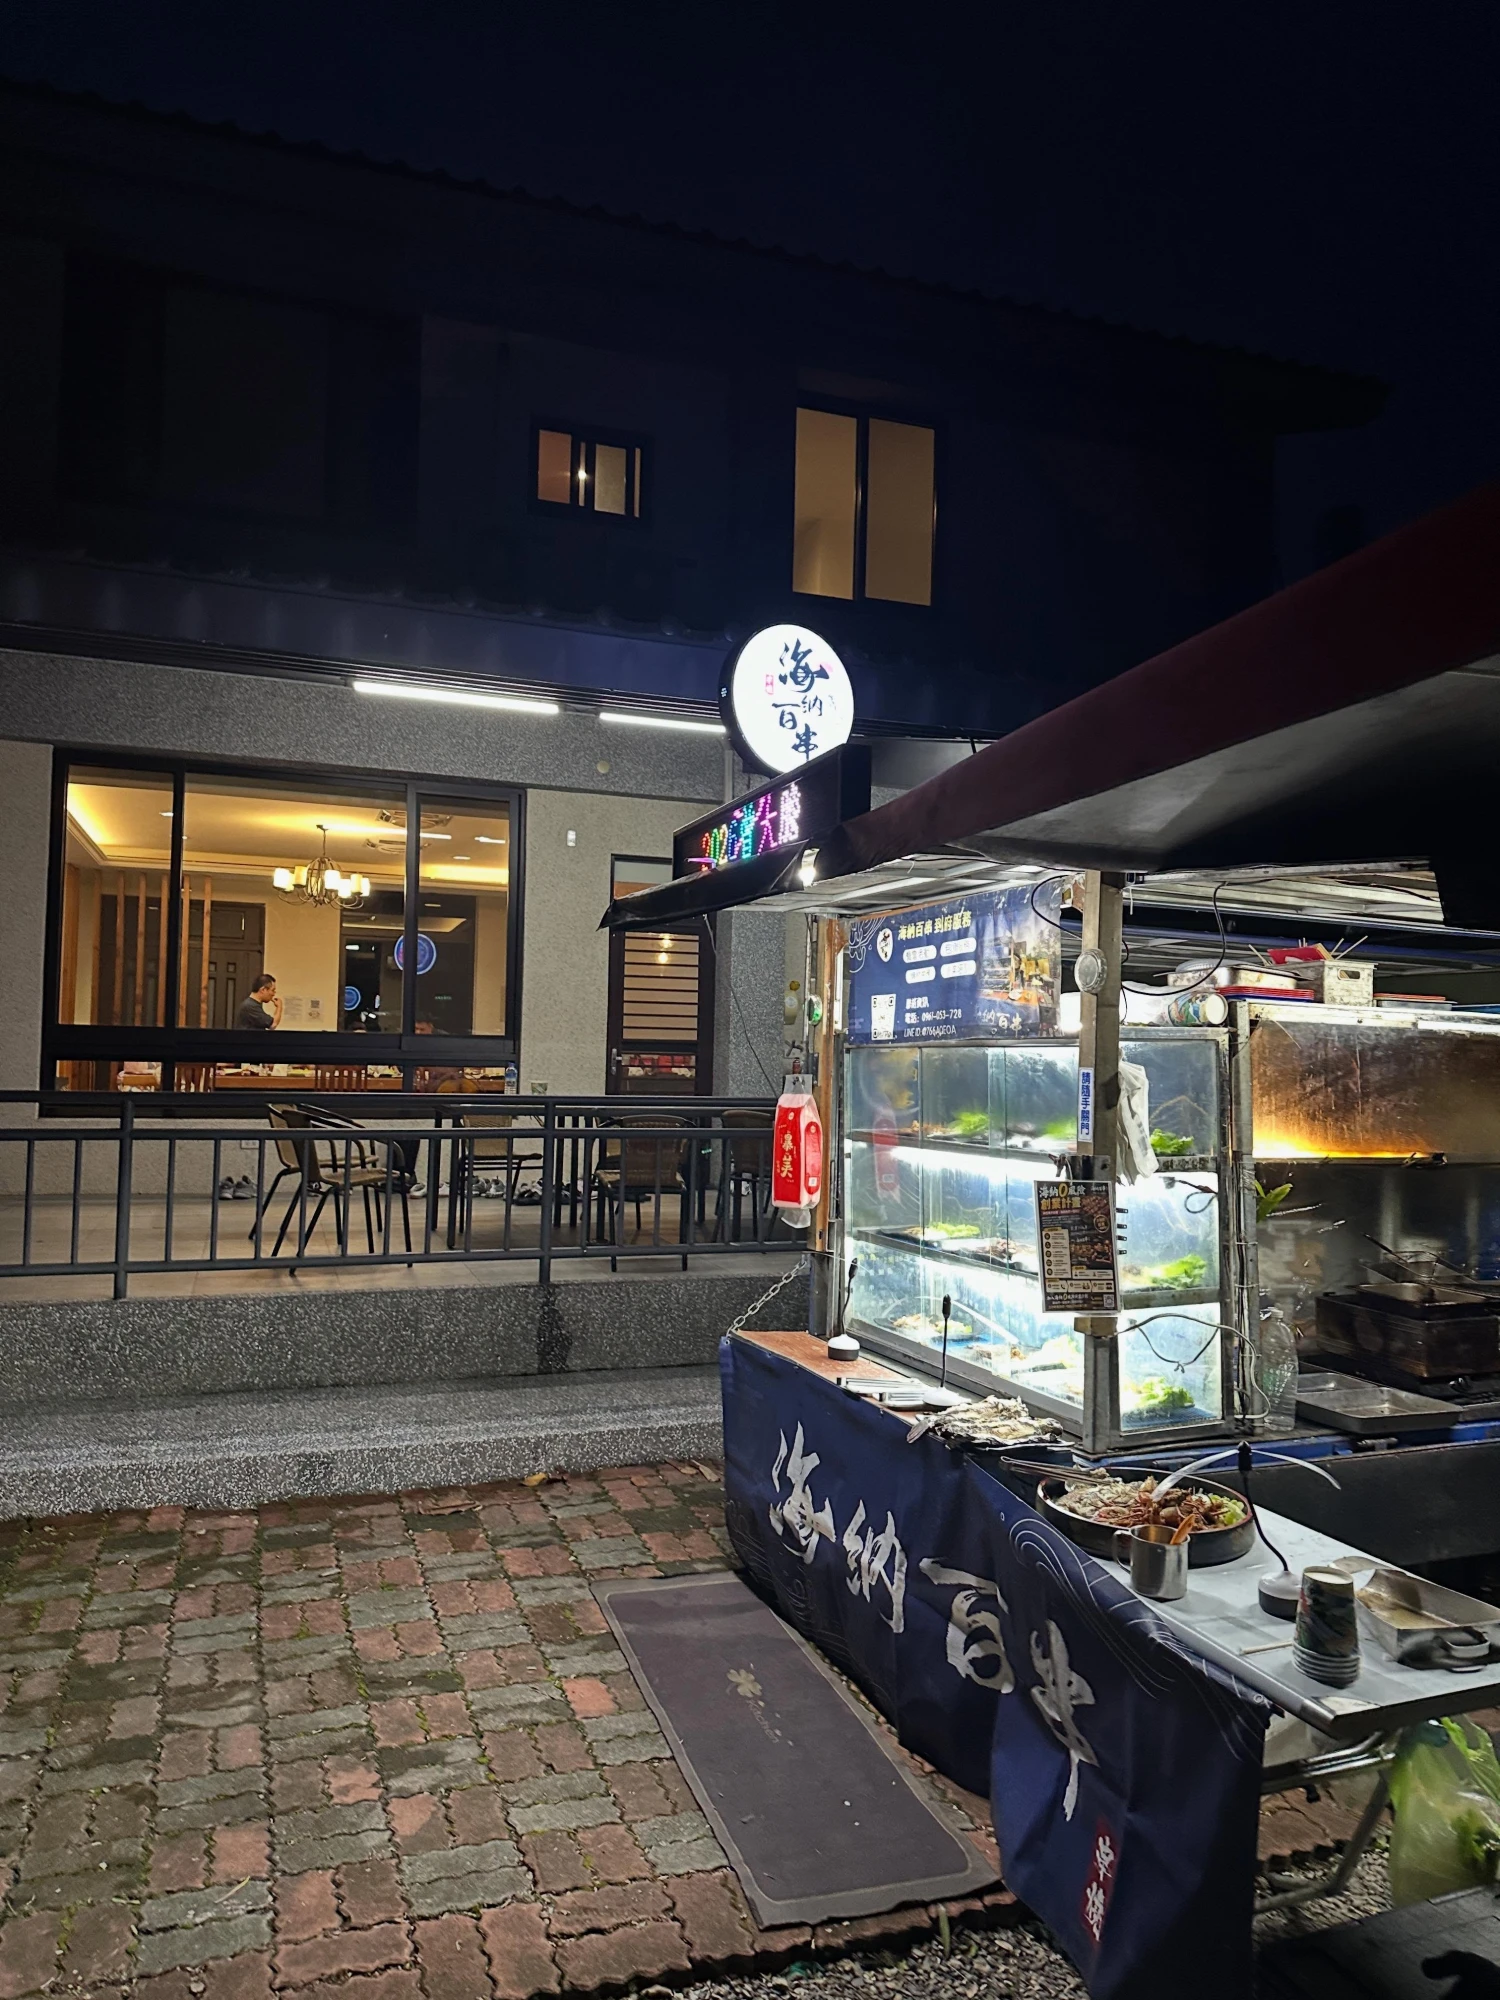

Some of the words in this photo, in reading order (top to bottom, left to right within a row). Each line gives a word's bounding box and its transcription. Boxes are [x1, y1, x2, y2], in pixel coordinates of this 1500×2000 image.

[897, 919, 932, 941] 海納百串
[934, 910, 972, 933] 到府服務
[770, 1421, 1098, 1821] 海納百串
[745, 1699, 780, 1744] Kitchen
